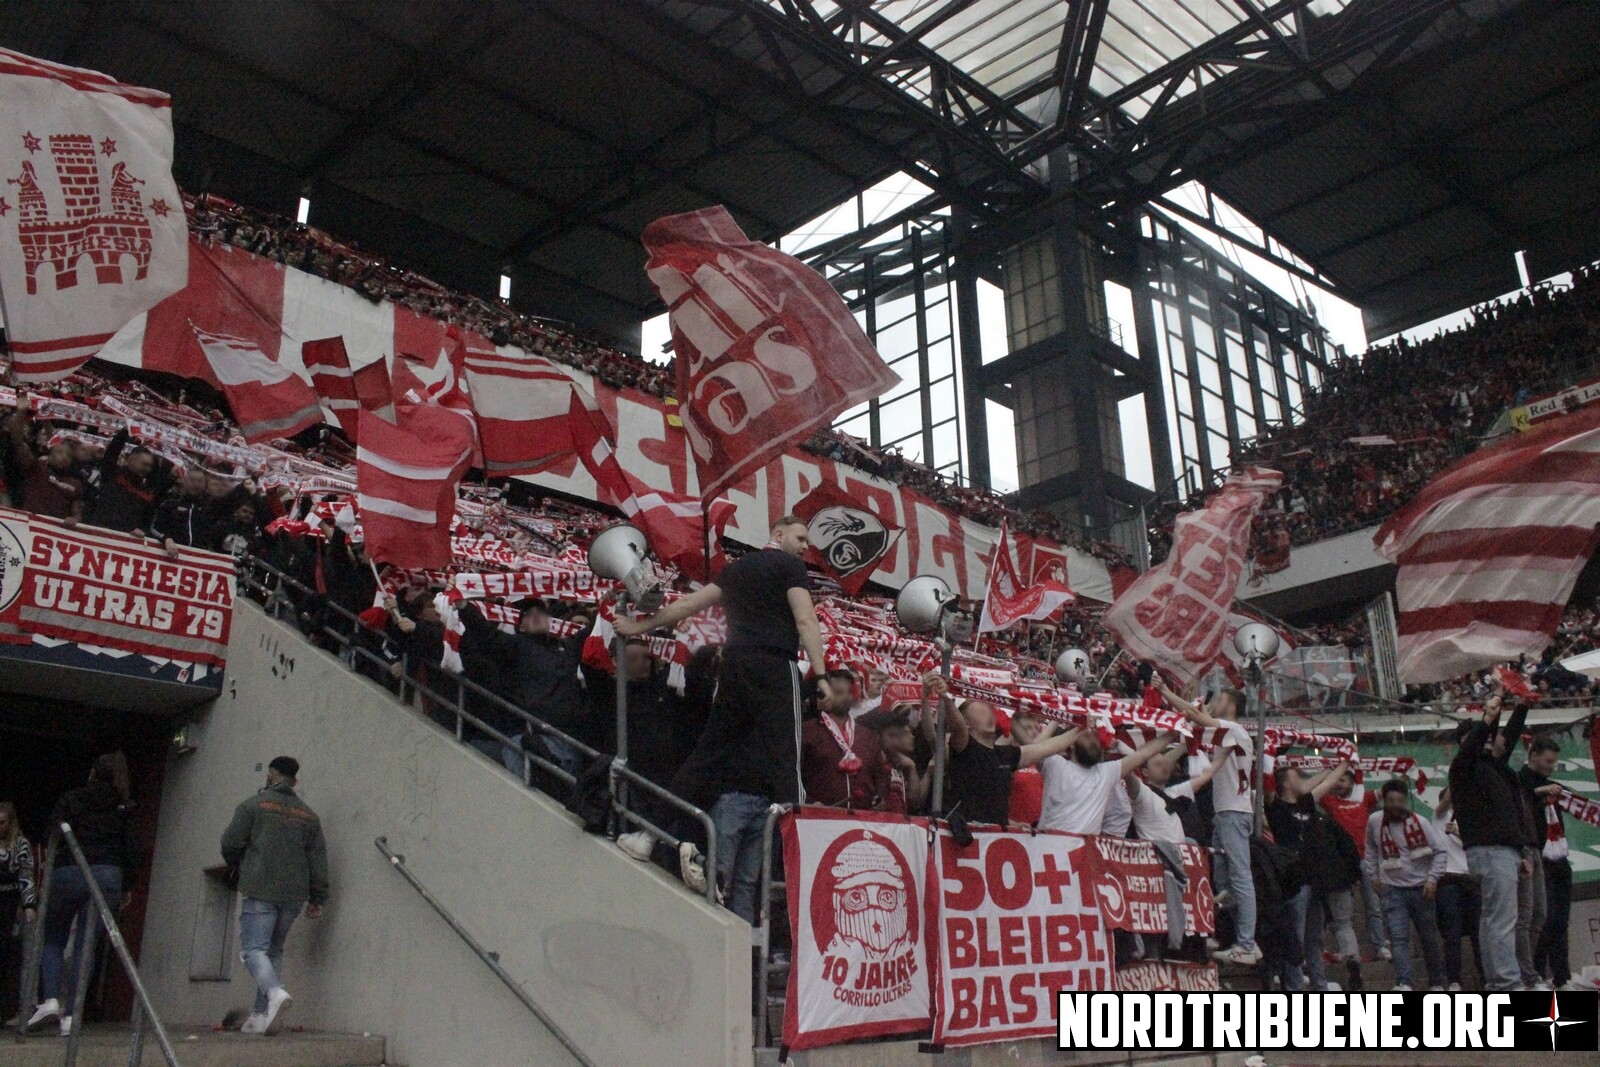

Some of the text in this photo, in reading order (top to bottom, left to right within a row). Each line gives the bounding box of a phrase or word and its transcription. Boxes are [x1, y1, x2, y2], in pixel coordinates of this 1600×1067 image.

[23, 235, 152, 261] SYNTHESIA
[1530, 400, 1556, 416] Red
[29, 535, 233, 607] SYNTHESIA
[34, 574, 175, 630] ULTRAS
[186, 605, 223, 639] 79
[945, 914, 1105, 969] BLEIBT.
[820, 947, 919, 991] 10 JAHRE
[833, 979, 912, 1007] CORRILLO ULTRAS
